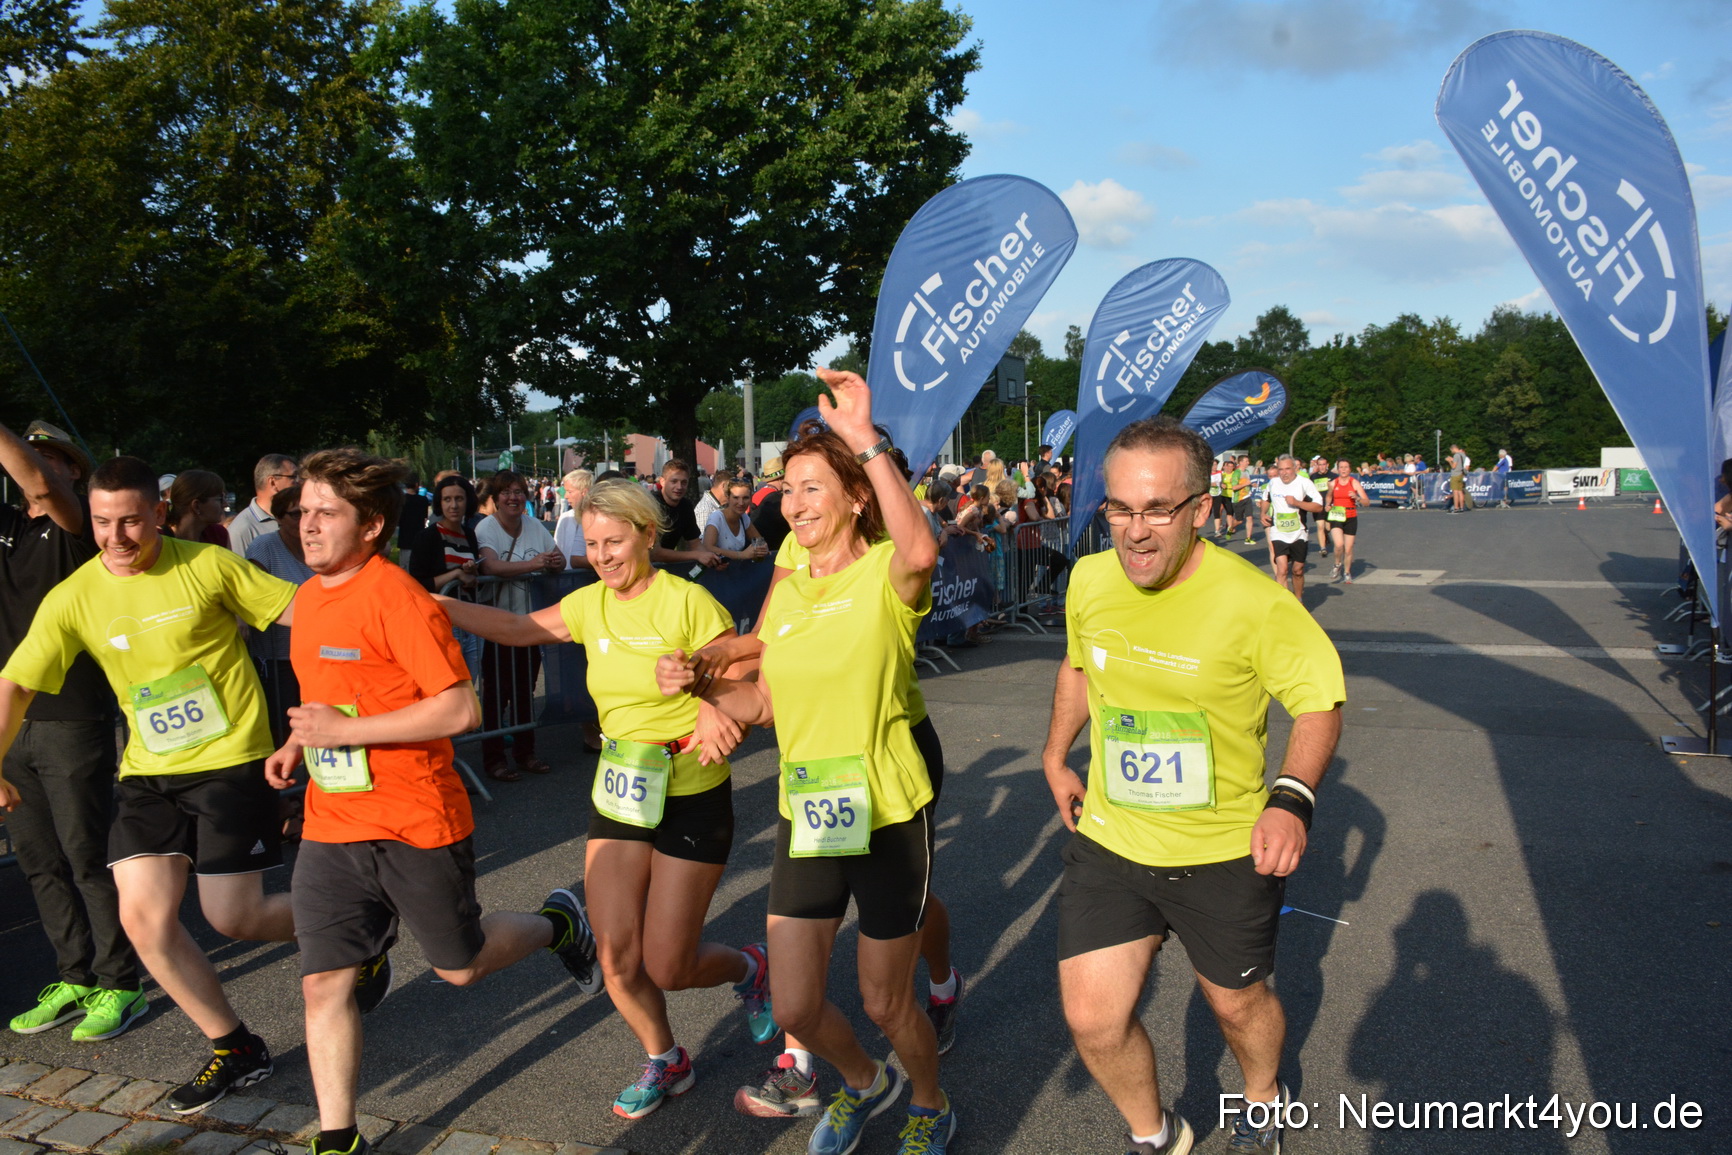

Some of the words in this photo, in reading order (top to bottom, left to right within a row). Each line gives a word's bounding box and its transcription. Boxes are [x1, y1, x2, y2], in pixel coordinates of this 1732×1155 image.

[921, 212, 1033, 365] Fischer
[959, 242, 1045, 365] AUTOMOBILE
[1115, 282, 1196, 394] Fischer
[1144, 302, 1206, 392] AUTOMOBILE
[1050, 415, 1071, 446] Fischer
[1224, 422, 1244, 436] Druck
[1257, 399, 1282, 418] Medien
[1623, 472, 1645, 483] AOK
[1280, 519, 1295, 528] 295
[1132, 645, 1157, 655] Kliniken
[1157, 650, 1167, 658] des
[1167, 652, 1201, 664] Landkreises
[1148, 656, 1177, 667] Neumarkt
[149, 699, 204, 734] 656
[1120, 749, 1183, 784] 621
[604, 768, 648, 802] 605
[1128, 789, 1154, 798] Thomas
[1155, 791, 1182, 799] Fischer
[804, 797, 855, 830] 635
